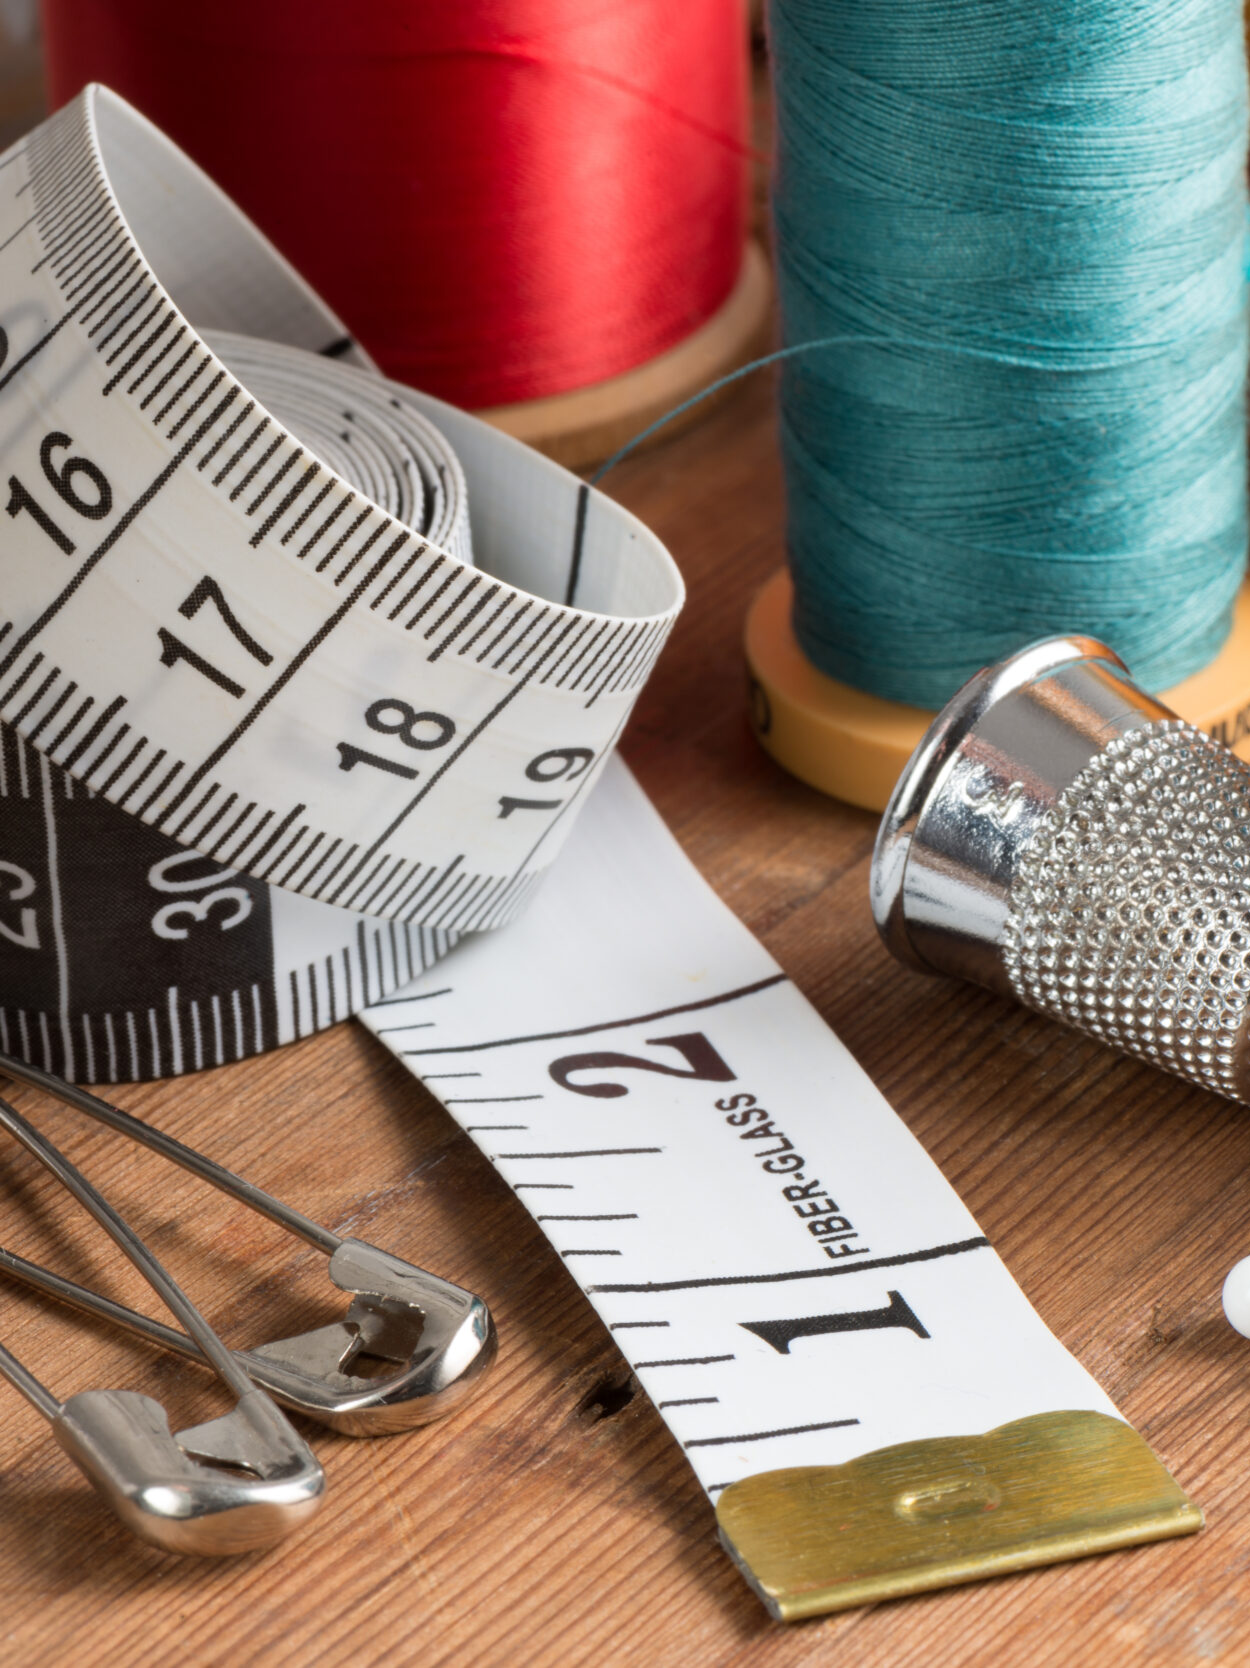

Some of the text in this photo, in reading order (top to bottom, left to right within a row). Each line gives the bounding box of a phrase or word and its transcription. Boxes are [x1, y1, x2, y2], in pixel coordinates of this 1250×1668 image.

[5, 431, 112, 556] 16
[160, 575, 273, 698] 17
[337, 698, 456, 779] 18
[497, 746, 596, 819] 19
[148, 849, 253, 940] 30
[548, 1031, 737, 1098] 2
[737, 1290, 931, 1354] 1
